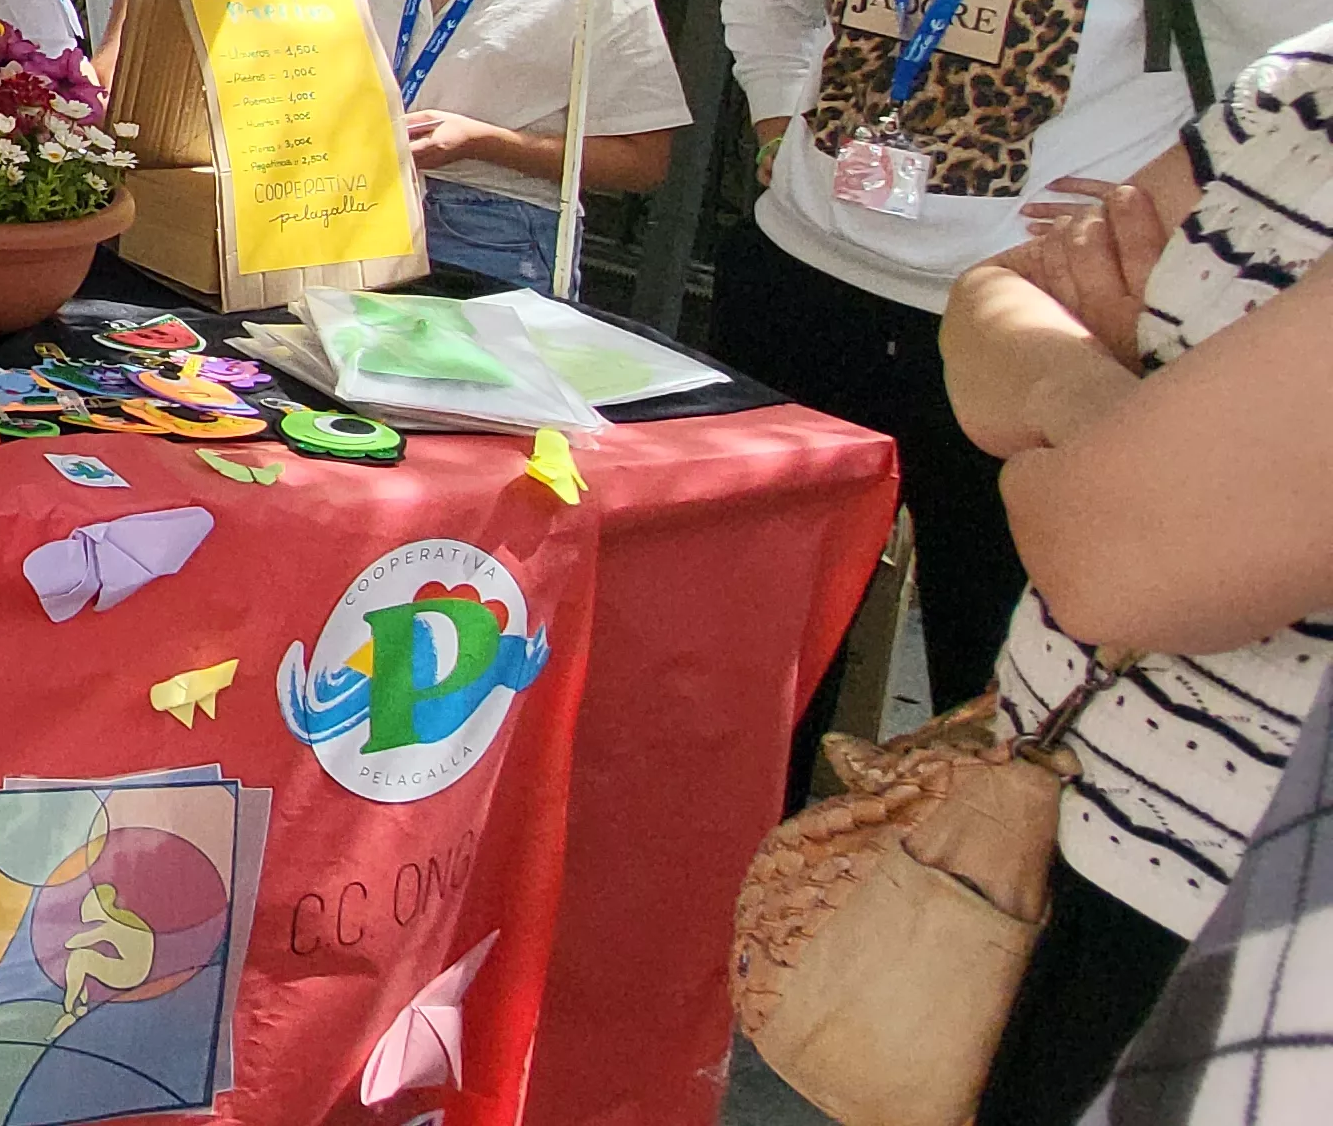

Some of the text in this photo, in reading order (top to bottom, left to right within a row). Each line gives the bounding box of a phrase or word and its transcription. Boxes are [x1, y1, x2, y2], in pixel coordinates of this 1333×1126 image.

[269, 195, 378, 233] pelagalla
[345, 547, 497, 606] COOPERATIVA
[360, 745, 473, 786] PELAGALLA
